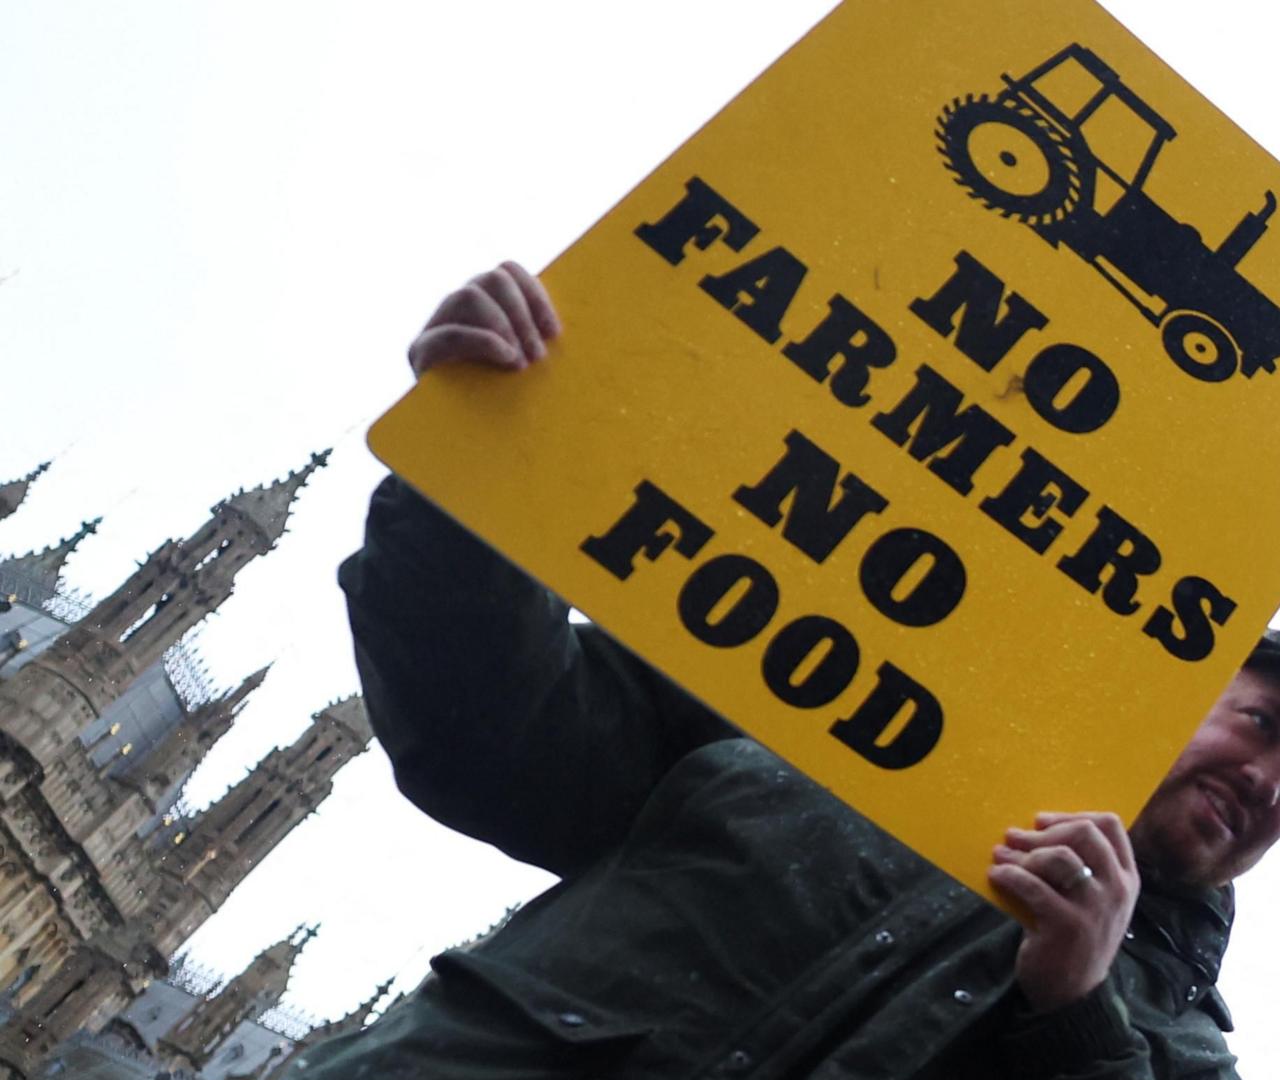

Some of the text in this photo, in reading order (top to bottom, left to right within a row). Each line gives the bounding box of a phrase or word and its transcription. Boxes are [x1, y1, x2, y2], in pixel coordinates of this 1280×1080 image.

[632, 175, 1238, 663] FARMERS
[907, 249, 1121, 435] NO
[578, 478, 945, 772] FOOD
[730, 428, 968, 629] NO
